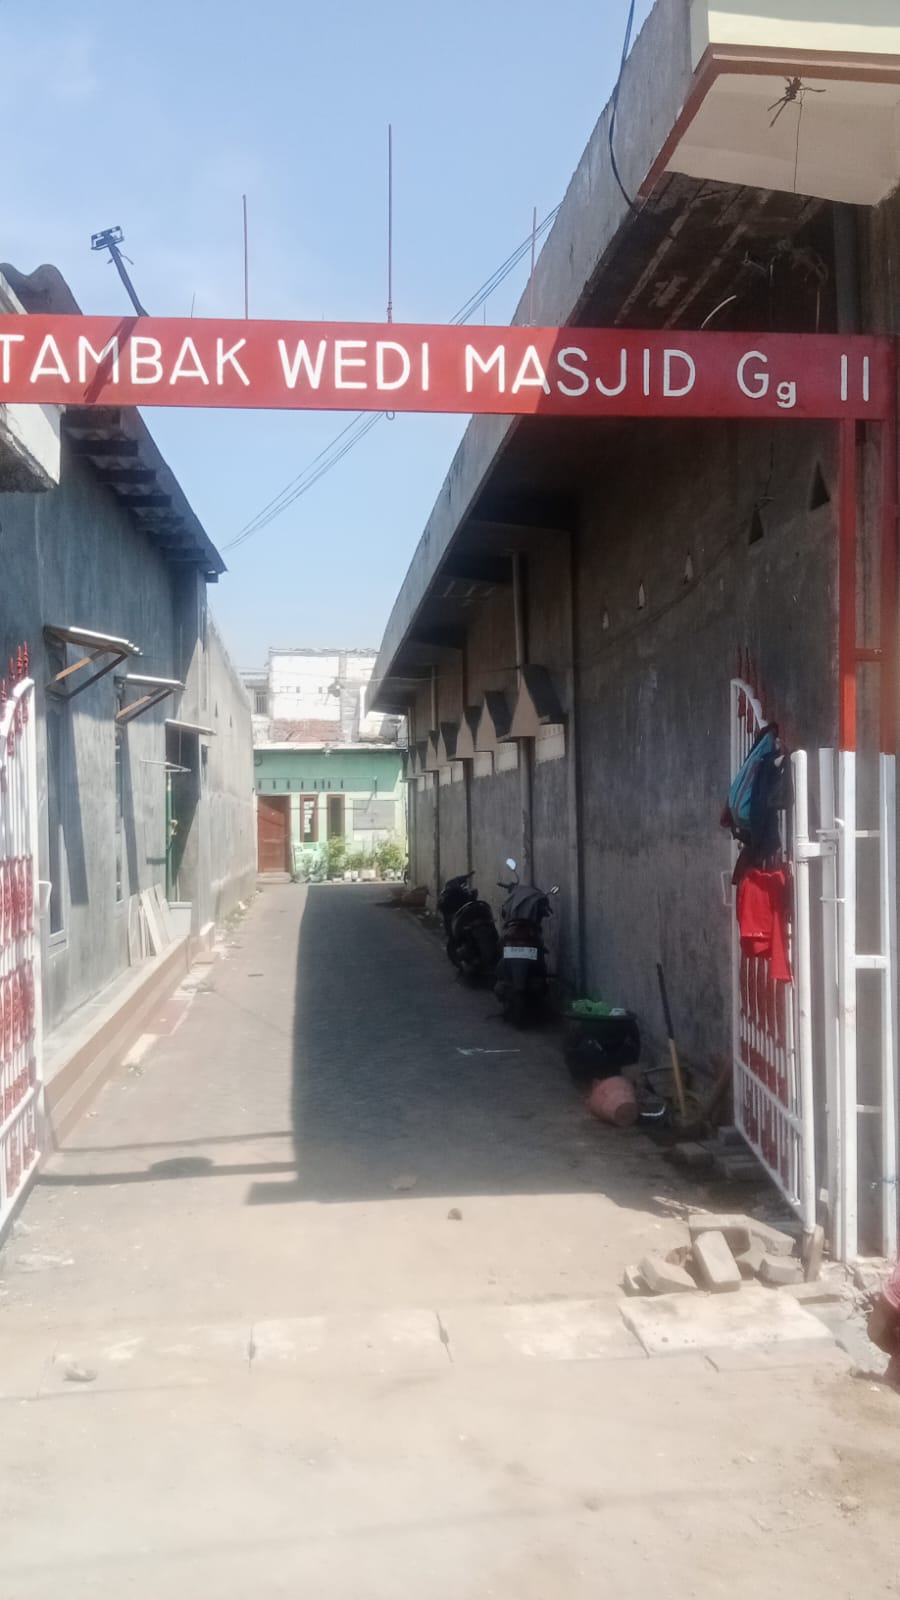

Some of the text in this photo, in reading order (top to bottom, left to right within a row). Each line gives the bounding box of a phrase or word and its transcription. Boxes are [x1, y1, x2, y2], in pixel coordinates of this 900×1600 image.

[0, 334, 250, 387] TAMBAK
[277, 338, 430, 391] WEDI
[464, 343, 697, 397] MASJID
[736, 350, 797, 409] Gg
